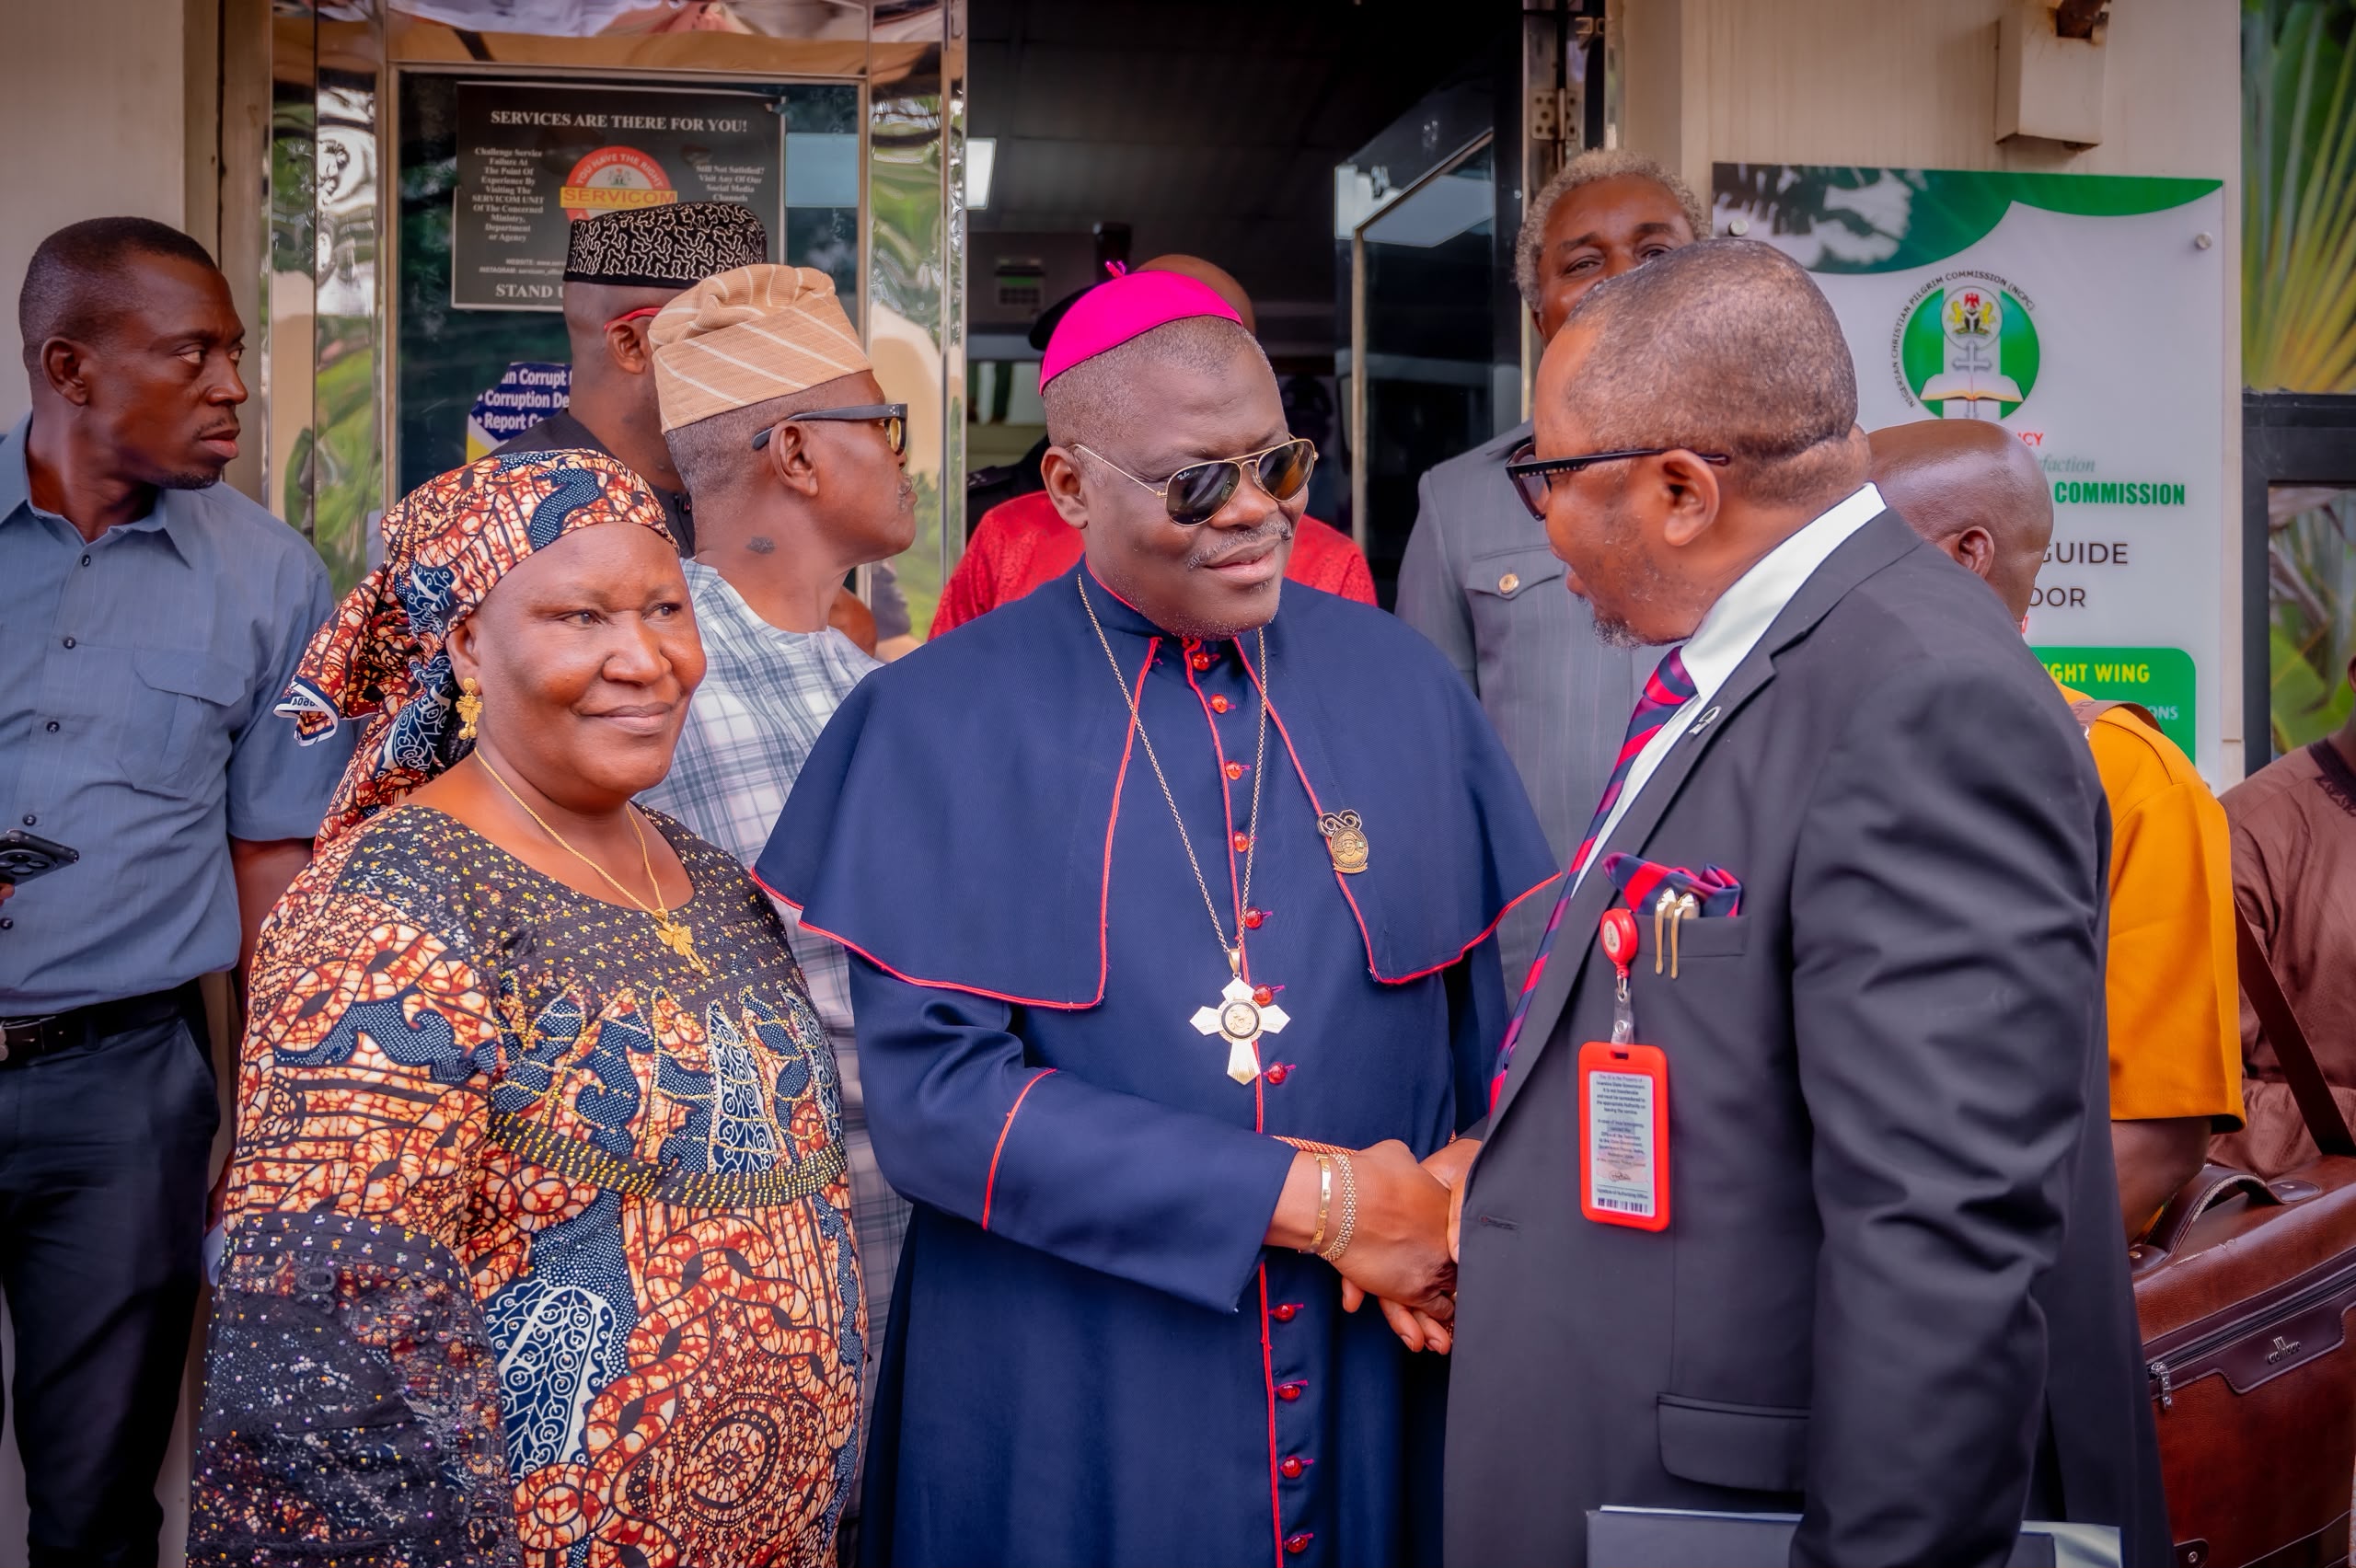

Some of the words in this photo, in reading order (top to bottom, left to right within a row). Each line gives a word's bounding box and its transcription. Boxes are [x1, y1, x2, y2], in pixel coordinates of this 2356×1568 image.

[491, 110, 571, 126] SERVICES
[573, 114, 607, 127] ARE
[611, 115, 666, 130] THERE
[671, 118, 704, 131] FOR
[706, 119, 747, 133] YOU!
[474, 147, 513, 156] Challenge
[514, 149, 542, 157] Service
[575, 166, 592, 184] YOU
[592, 154, 618, 167] HAVE
[620, 154, 640, 163] THE
[641, 162, 664, 187] RIGHT
[472, 194, 520, 202] SERVICOM
[564, 188, 676, 203] SERVICOM
[502, 205, 544, 213] Concerned
[485, 223, 531, 233] Department
[1946, 271, 2007, 286] COMMISSION
[495, 283, 553, 298] STAND
[1910, 277, 1943, 306] PILGRIM
[2008, 283, 2036, 311] (NCPC)
[1891, 306, 1911, 358] CHRISTIAN
[519, 368, 567, 388] Corrupt
[1892, 362, 1915, 408] NIGERIAN
[484, 389, 550, 410] Corruption
[484, 411, 526, 432] Report
[2017, 432, 2044, 446] CY
[2040, 454, 2096, 472] faction
[2054, 481, 2185, 505] COMMISSION
[2044, 663, 2087, 683] GHT
[2095, 663, 2150, 683] WING
